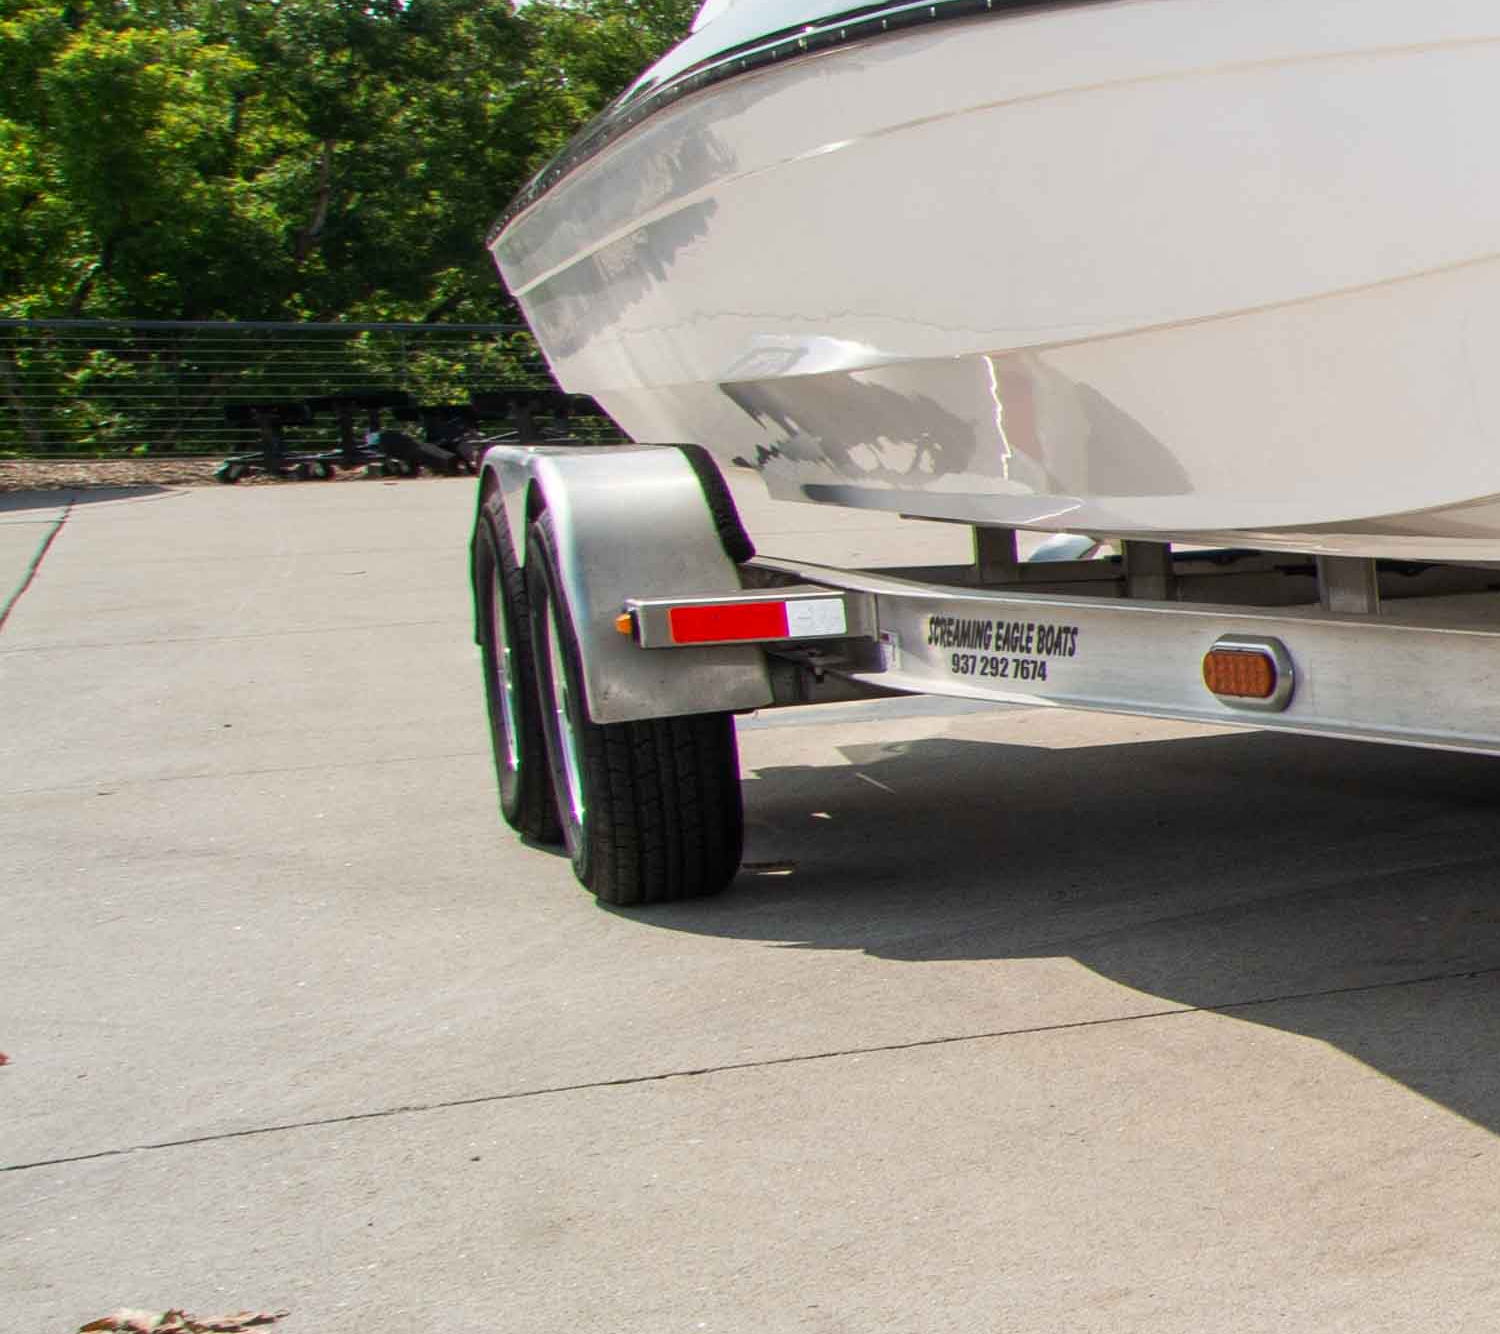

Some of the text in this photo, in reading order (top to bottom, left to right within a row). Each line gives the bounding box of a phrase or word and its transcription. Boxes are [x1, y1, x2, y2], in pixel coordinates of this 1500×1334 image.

[928, 616, 1079, 657] SCREAMING EAGLE BOATS
[952, 653, 1047, 681] 937 292 7674
